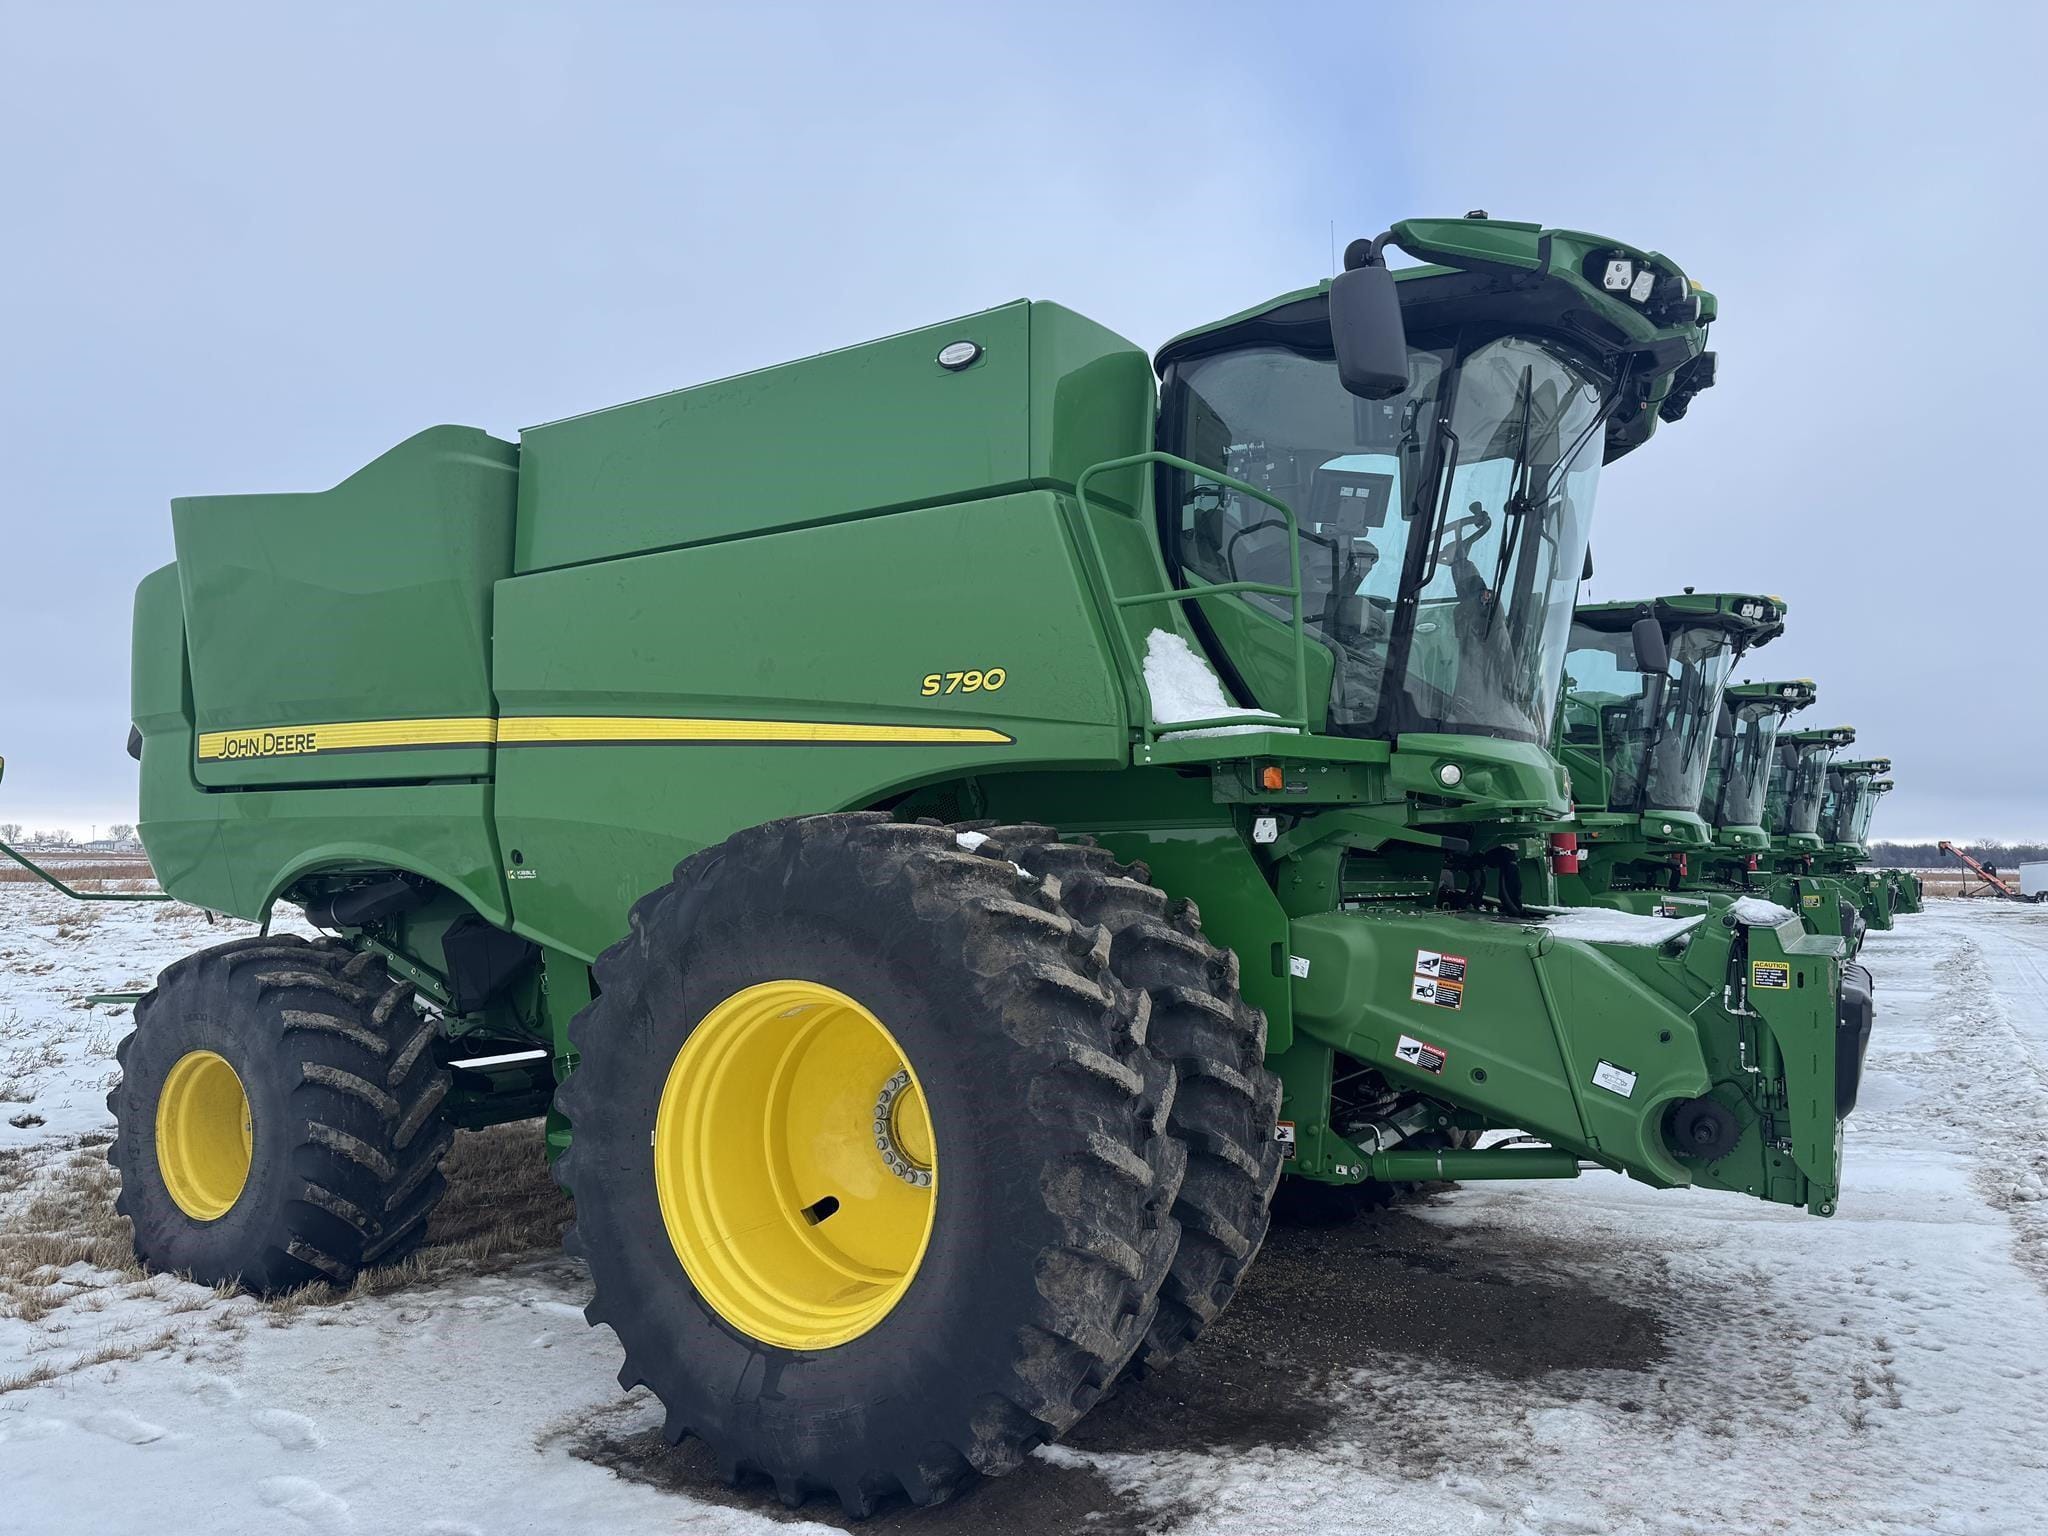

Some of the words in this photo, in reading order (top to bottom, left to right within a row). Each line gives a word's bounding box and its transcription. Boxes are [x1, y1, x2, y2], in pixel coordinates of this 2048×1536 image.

[920, 667, 1007, 696] S790
[219, 737, 260, 756] JOHN
[263, 733, 316, 753] DEERE
